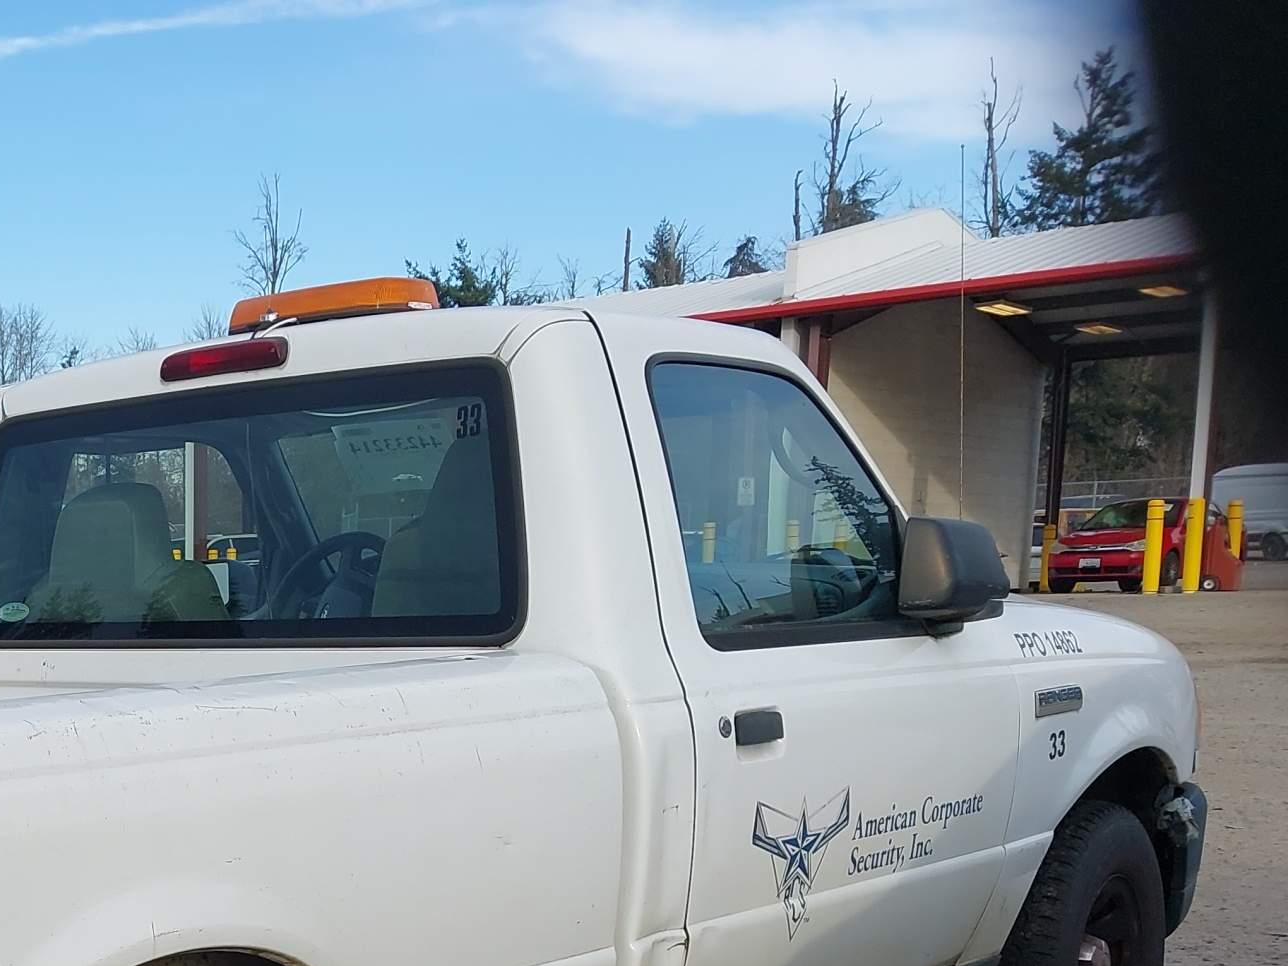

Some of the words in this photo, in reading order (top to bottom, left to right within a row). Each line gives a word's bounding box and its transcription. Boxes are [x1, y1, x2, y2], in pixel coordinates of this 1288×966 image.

[456, 402, 482, 439] 33
[1014, 631, 1047, 658] PPO
[1044, 630, 1083, 655] 14862
[1049, 730, 1066, 760] 33
[852, 803, 917, 841] American
[921, 793, 985, 830] Corporate
[847, 839, 906, 873] Security,
[909, 833, 934, 860] Inc.
